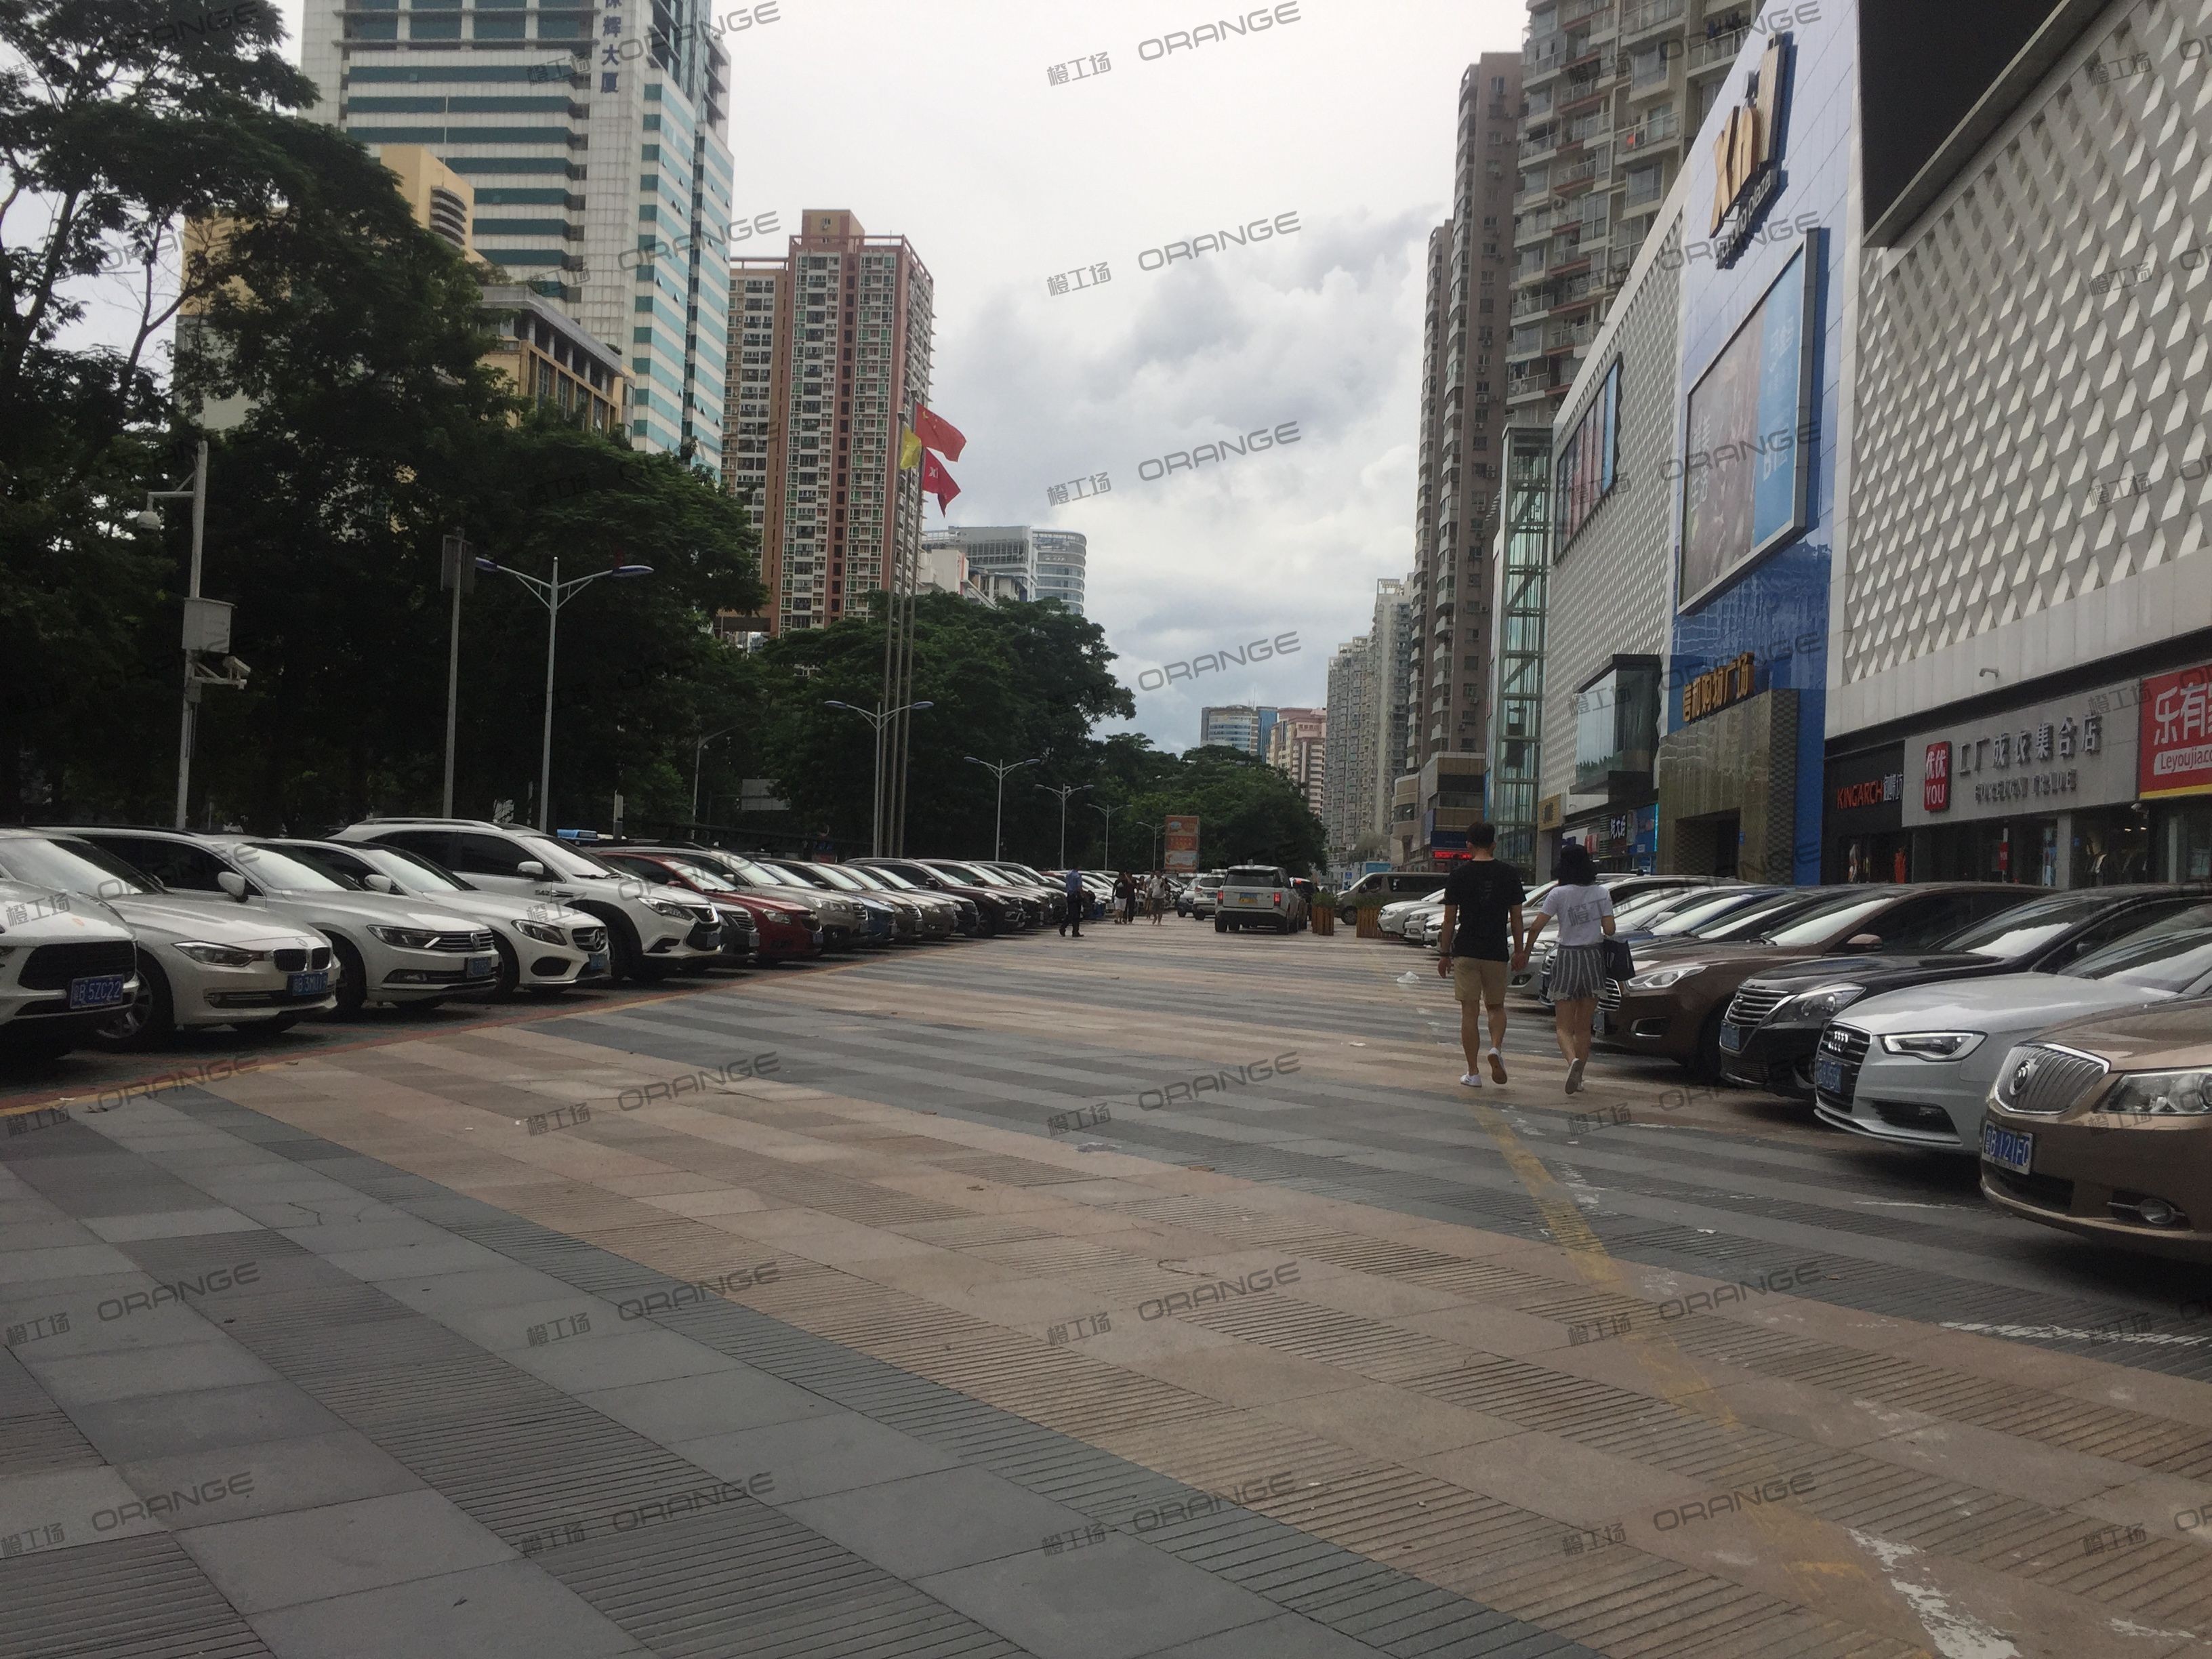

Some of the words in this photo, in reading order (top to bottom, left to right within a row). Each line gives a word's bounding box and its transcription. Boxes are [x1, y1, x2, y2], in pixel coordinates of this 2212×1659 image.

[2154, 682, 2212, 745] 乐有
[1837, 780, 1883, 808] KINGARCH
[1926, 783, 1945, 805] YOU
